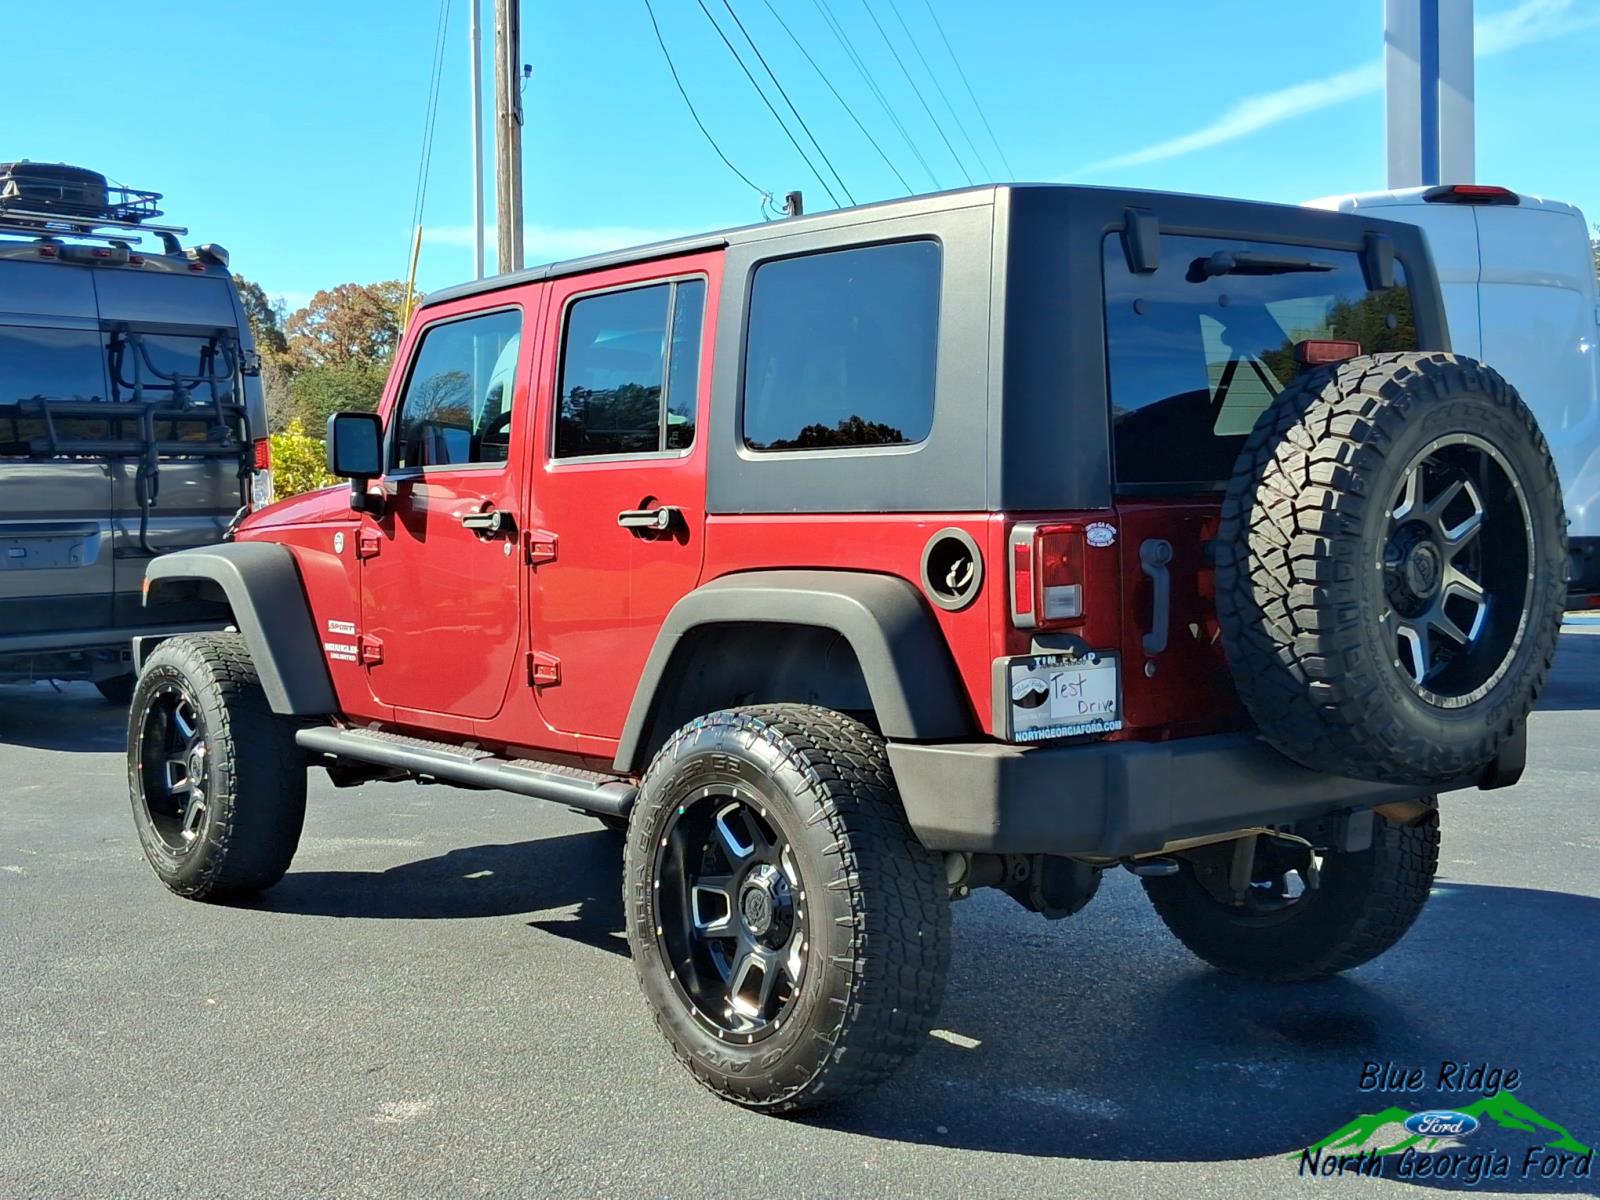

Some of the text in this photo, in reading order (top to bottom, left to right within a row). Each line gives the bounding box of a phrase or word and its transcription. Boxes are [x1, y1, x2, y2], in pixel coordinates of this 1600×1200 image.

[329, 621, 355, 633] SPORT
[1051, 673, 1087, 700] Test
[1078, 699, 1114, 714] Drive
[1015, 720, 1122, 743] NORTHGEORGIAFORD.COM
[711, 754, 742, 774] G2
